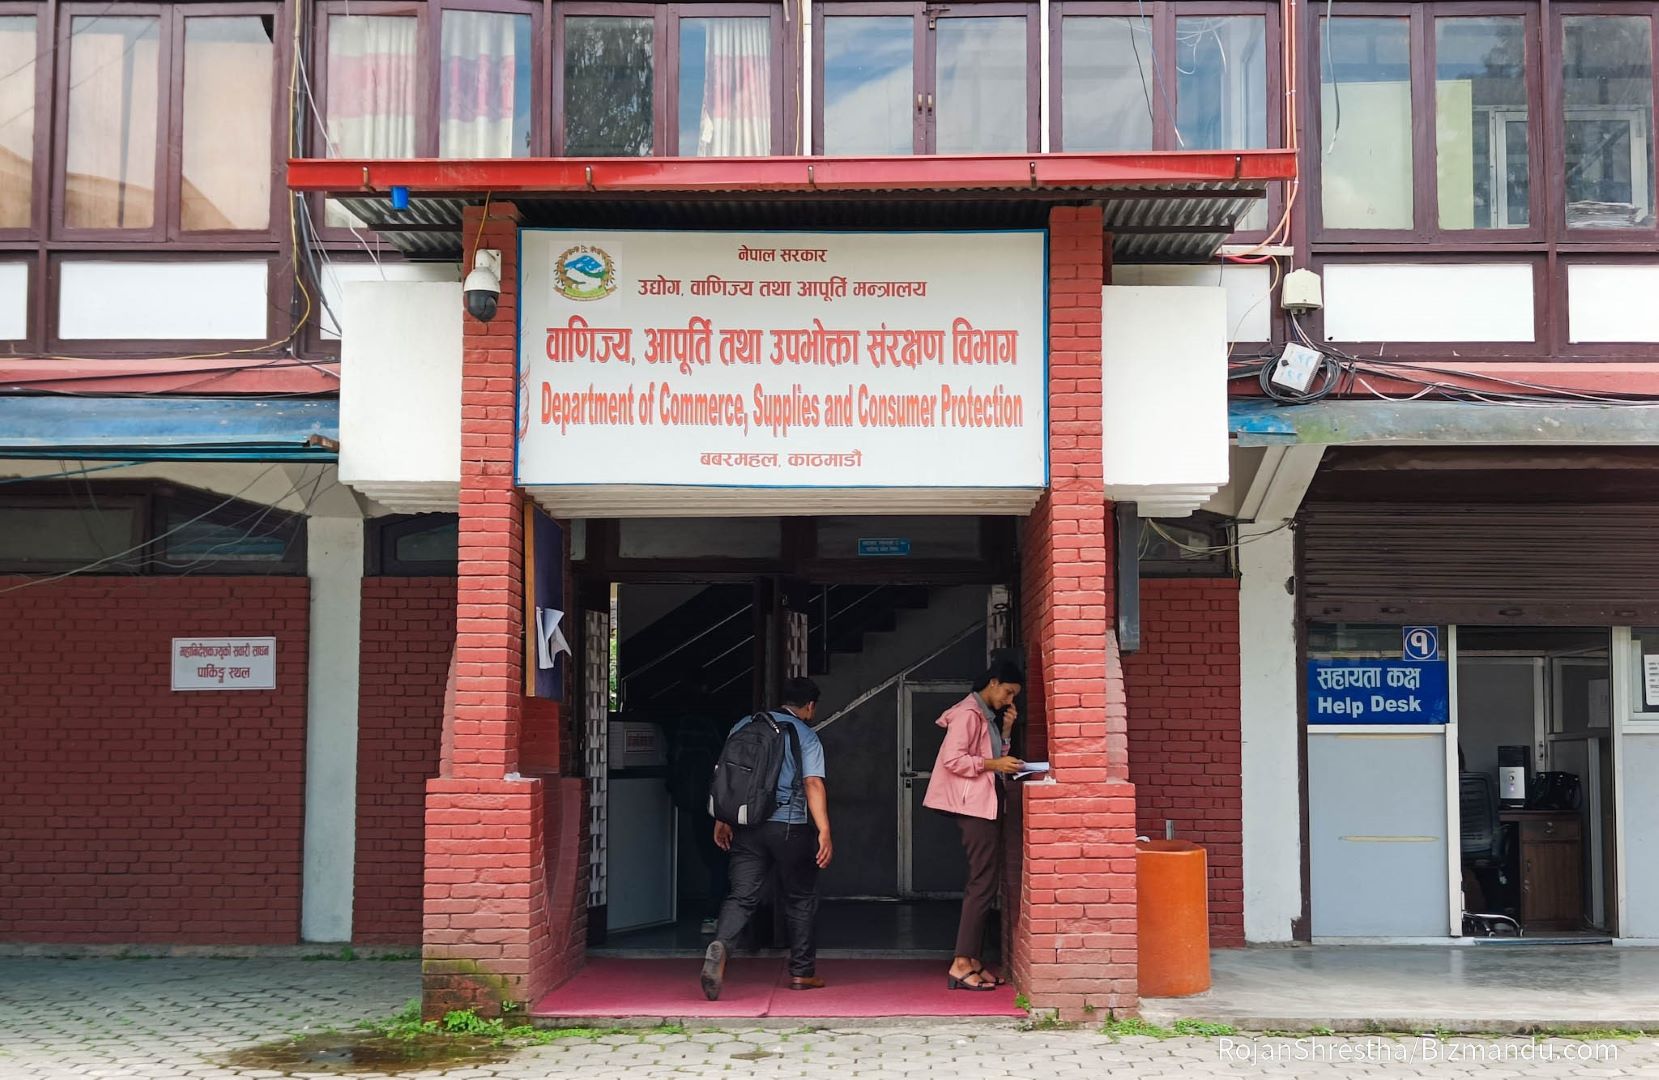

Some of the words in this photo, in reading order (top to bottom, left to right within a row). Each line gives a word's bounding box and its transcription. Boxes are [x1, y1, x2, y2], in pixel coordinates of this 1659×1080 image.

[738, 245, 776, 262] नेपाल
[780, 249, 828, 262] सरकार
[638, 274, 684, 297] उद्योग,
[690, 275, 754, 297] वाणिज्य
[759, 280, 792, 297] तथा
[797, 276, 847, 302] आपूर्ति
[853, 281, 927, 298] मन्त्रालय
[546, 315, 635, 366] वाणिज्य,
[644, 316, 713, 376] आपूर्ति
[719, 329, 763, 366] तथा
[769, 318, 860, 367] उपभोक्ता
[866, 322, 946, 370] संरक्षण
[952, 317, 1019, 366] विभाग
[541, 381, 635, 435] Department
[638, 381, 655, 426] of
[659, 382, 749, 437] Commerce,
[753, 383, 820, 437] Supplies
[824, 384, 854, 428] and
[858, 384, 937, 428] Consumer
[941, 384, 1024, 428] Protection
[700, 452, 782, 468] बबरमहल,
[228, 667, 250, 679] स्थल
[1316, 668, 1382, 690] सहायता
[1387, 668, 1422, 691] कक्ष
[1317, 697, 1364, 718] Help
[1370, 695, 1422, 712] Desk
